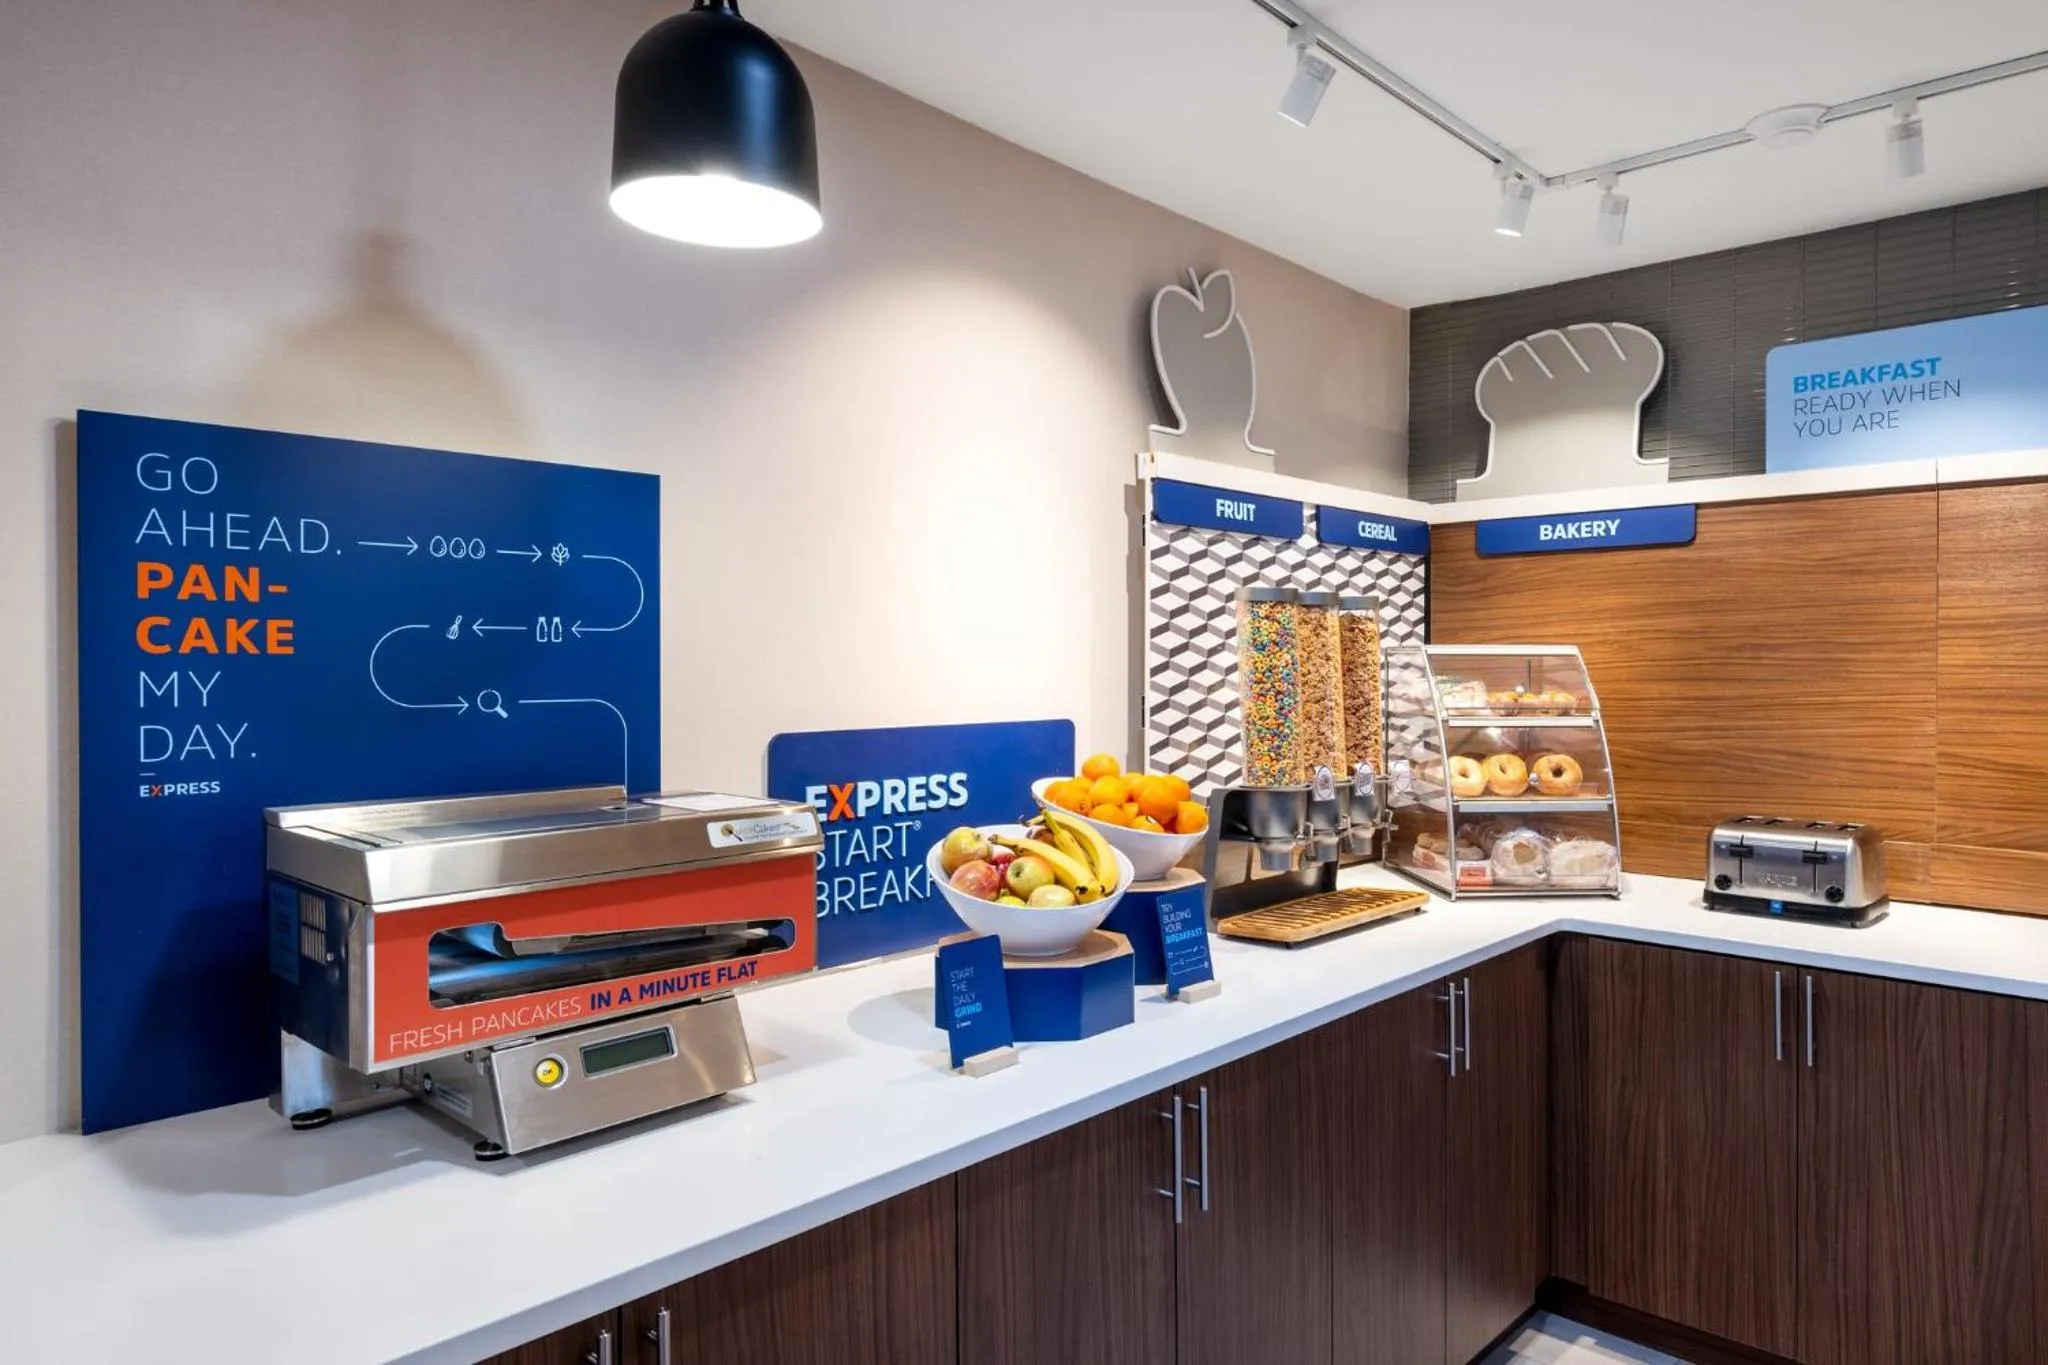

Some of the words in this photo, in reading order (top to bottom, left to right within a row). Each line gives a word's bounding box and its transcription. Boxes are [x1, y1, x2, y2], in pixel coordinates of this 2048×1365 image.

[1793, 356, 1943, 394] BREAKFAST
[1793, 389, 1872, 417] READY
[1881, 377, 1962, 406] WHEN
[1793, 416, 1843, 438] YOU
[1852, 410, 1900, 433] ARE
[136, 452, 219, 495] GO
[1215, 498, 1256, 523] FRUIT
[135, 507, 342, 555] AHEAD.
[1357, 520, 1398, 543] CEREAL
[1538, 518, 1622, 542] BAKERY
[136, 561, 289, 602] PAN-
[135, 616, 295, 655] CAKE
[140, 670, 221, 708] MY
[140, 722, 257, 763] DAY.
[139, 780, 221, 798] EXPRESS
[805, 772, 969, 822] EXPRESS
[1162, 909, 1192, 924] BUILDING
[1165, 922, 1182, 934] YOUR
[1165, 927, 1203, 944] BREAKFAST
[950, 966, 975, 983] START
[951, 980, 968, 993] THE
[389, 1021, 464, 1054] FRESH
[472, 996, 583, 1037] PANCAKES
[590, 990, 612, 1011] IN
[618, 987, 633, 1006] A
[638, 970, 711, 1001] MINUTE
[717, 960, 759, 990] FLAT
[953, 991, 977, 1007] DAILY
[954, 1002, 982, 1018] GRIND
